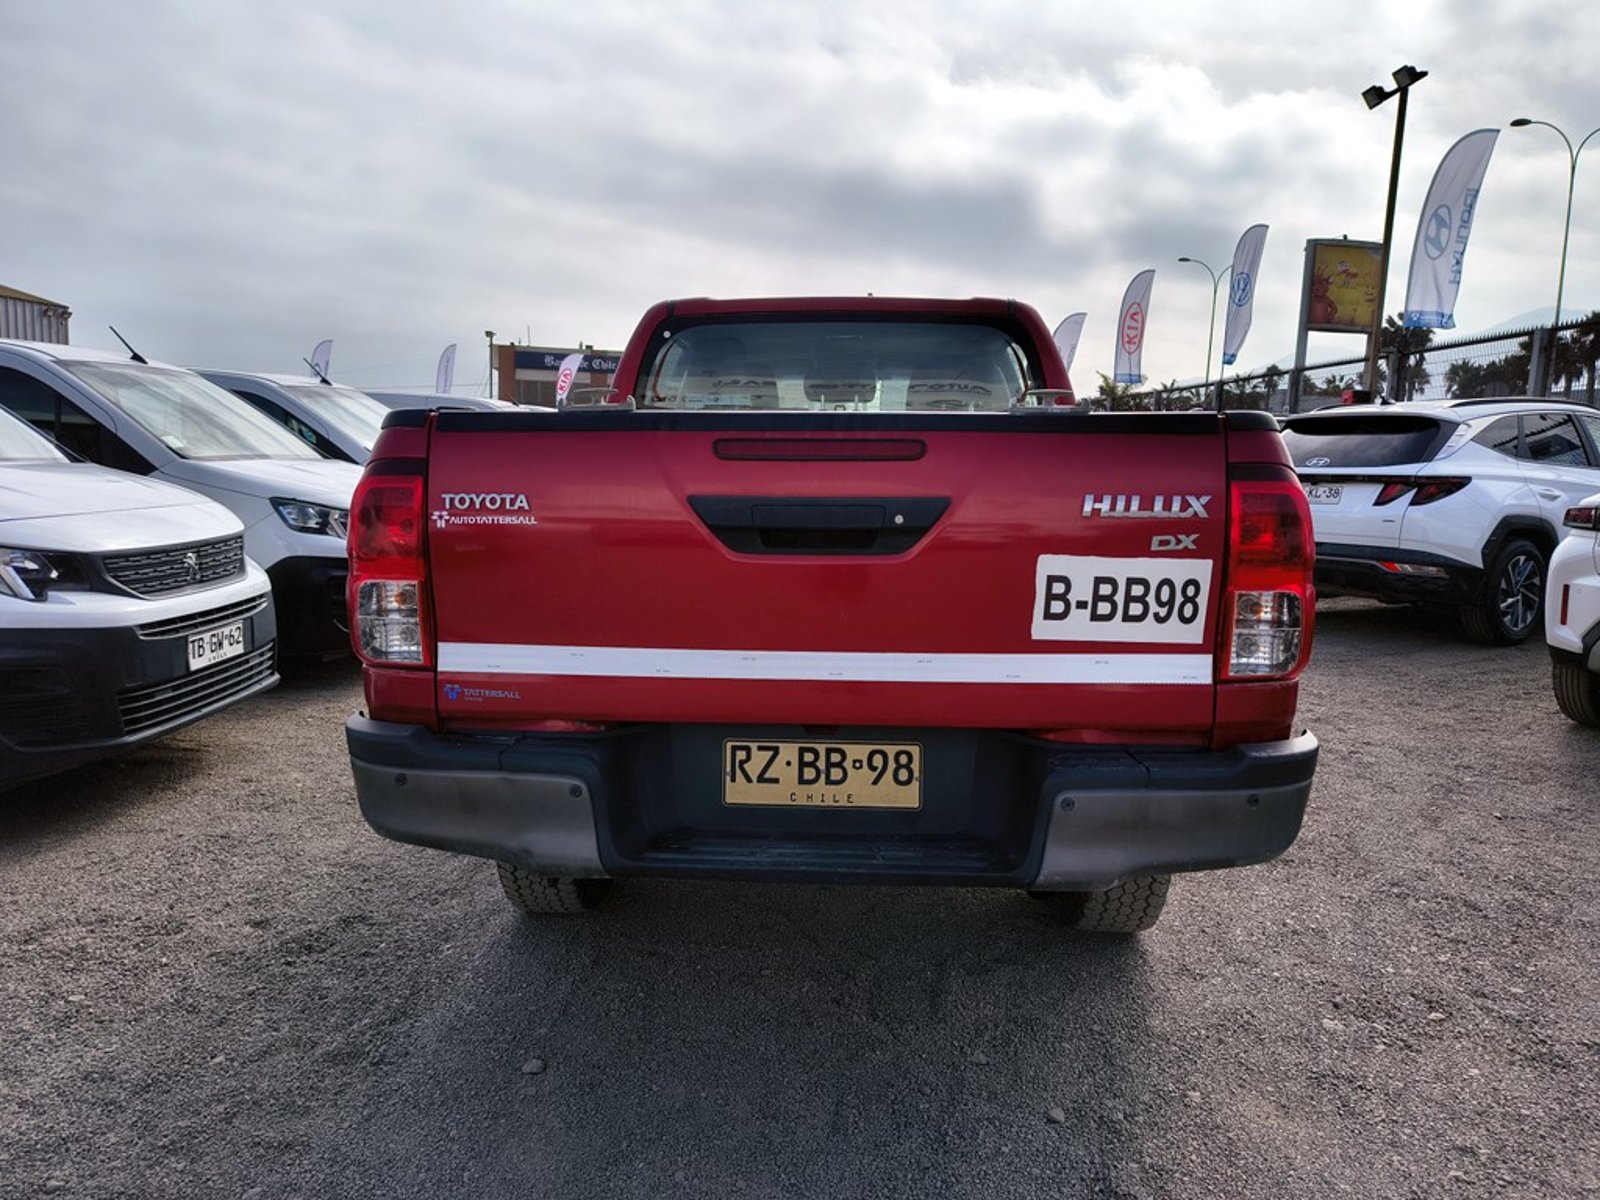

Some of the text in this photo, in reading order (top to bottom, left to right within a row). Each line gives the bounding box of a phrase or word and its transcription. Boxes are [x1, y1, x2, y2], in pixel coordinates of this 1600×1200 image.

[1126, 310, 1140, 346] KIA
[441, 493, 530, 510] TOYOTA
[1082, 494, 1212, 518] HILUX
[449, 515, 537, 525] AUTOTATTERSALL
[1150, 534, 1200, 551] DX
[1043, 574, 1201, 625] B-BB98
[789, 792, 854, 804] CHILE
